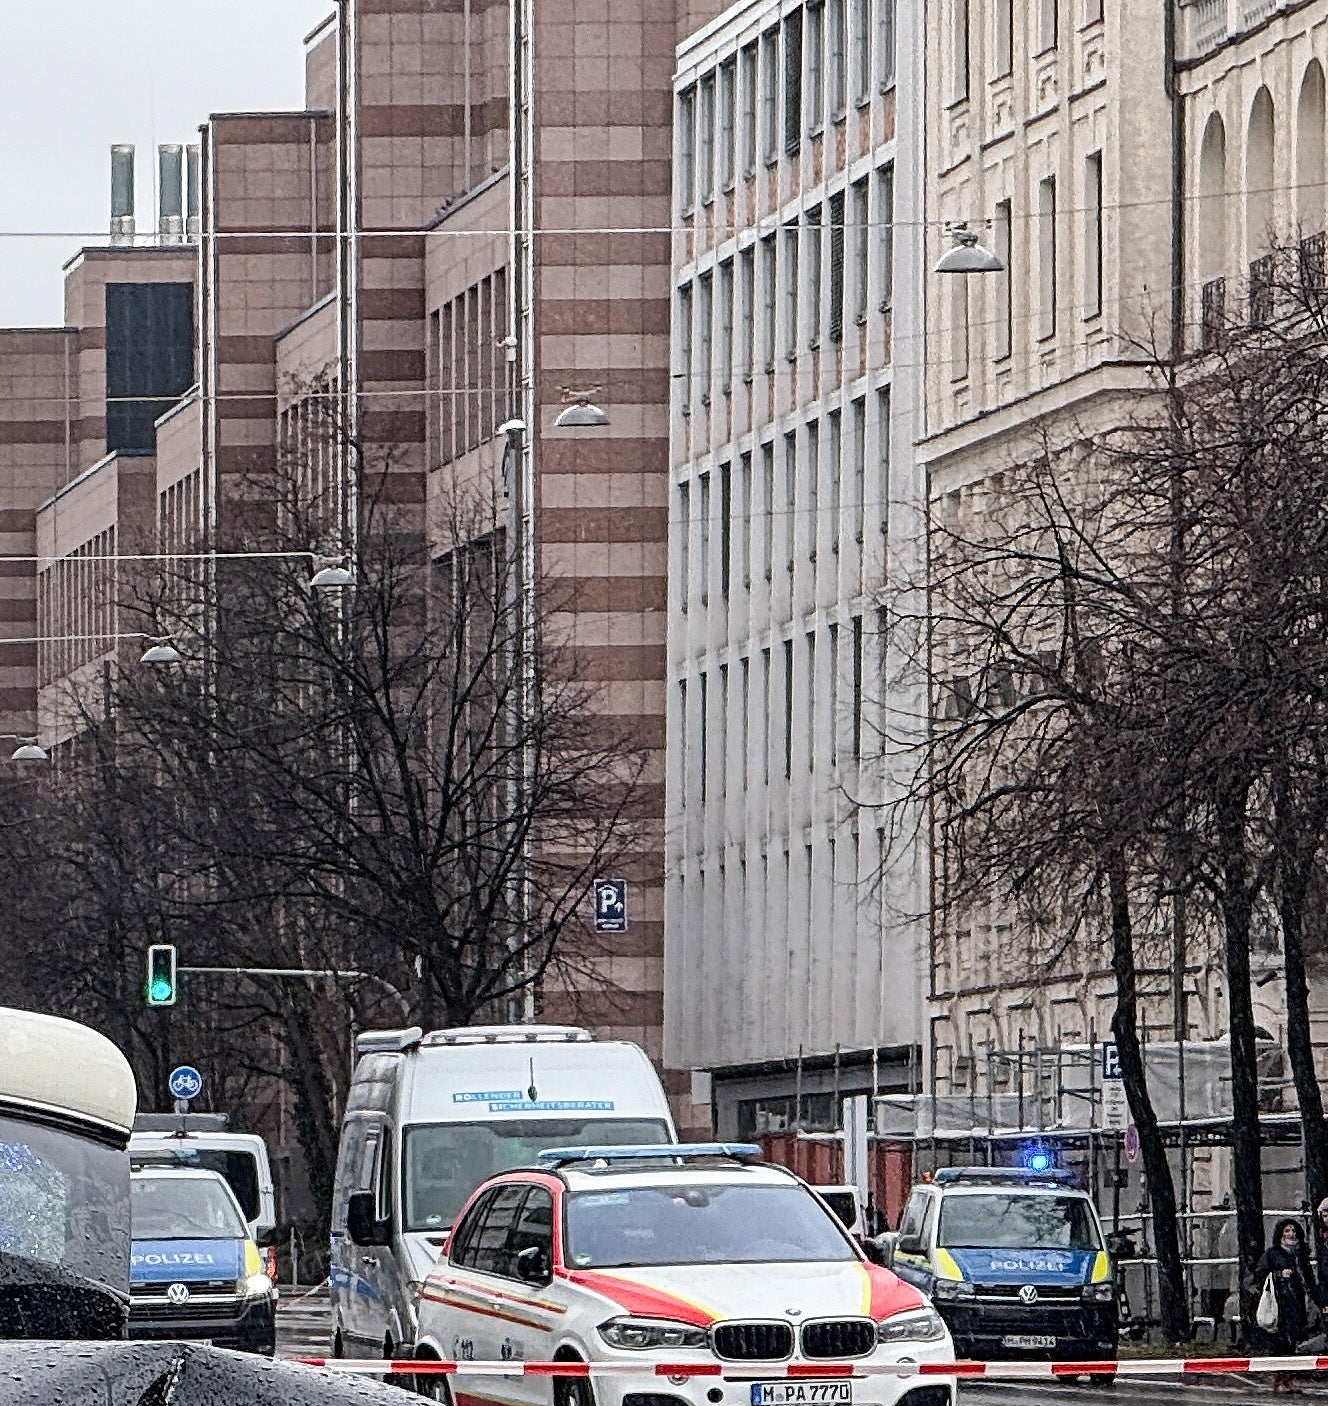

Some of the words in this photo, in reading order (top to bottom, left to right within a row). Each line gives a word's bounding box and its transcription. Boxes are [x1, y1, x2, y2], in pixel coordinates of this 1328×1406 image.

[131, 1253, 215, 1266] POLIZEI
[990, 1260, 1065, 1272] POLIZEI
[763, 1386, 775, 1402] M
[784, 1385, 807, 1402] PA
[809, 1384, 849, 1401] 7770
